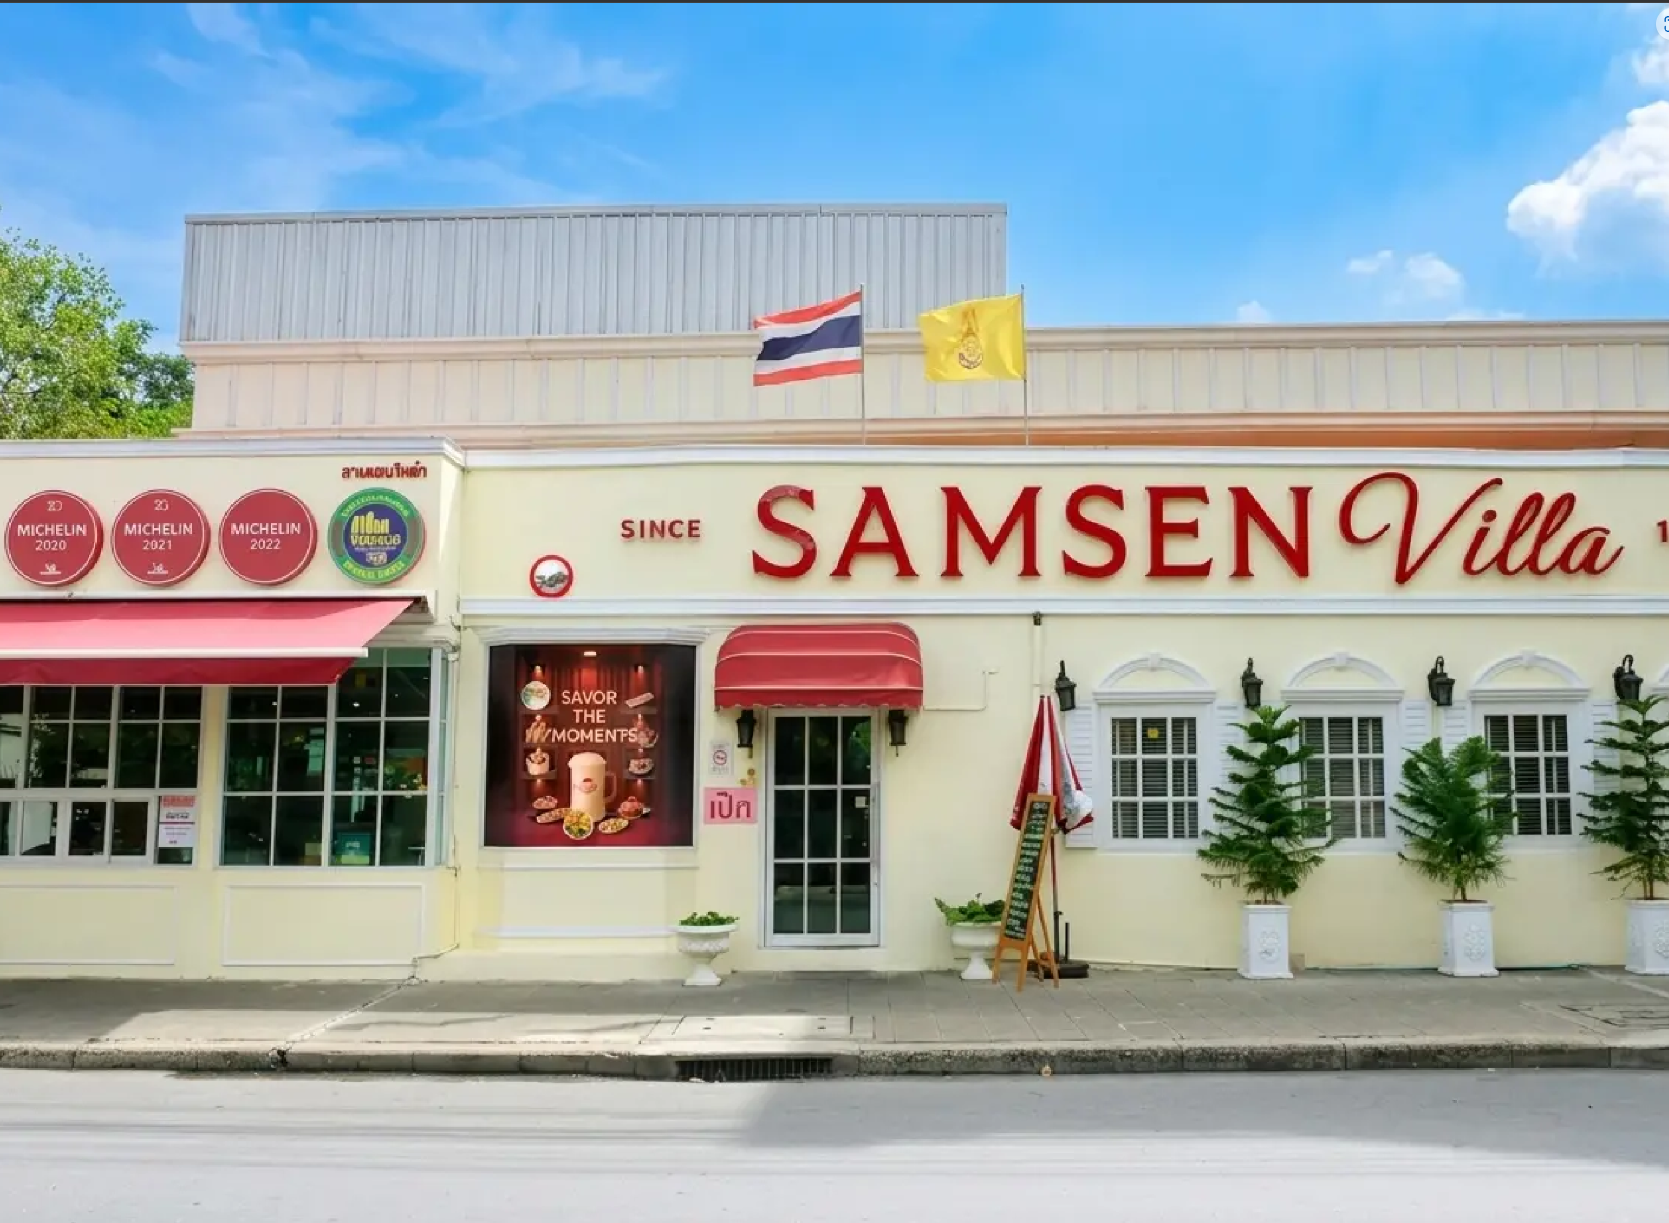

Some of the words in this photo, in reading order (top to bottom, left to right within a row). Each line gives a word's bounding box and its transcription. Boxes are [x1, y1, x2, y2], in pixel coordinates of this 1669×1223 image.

[17, 524, 87, 537] MICHELIN
[124, 522, 193, 536] MICHELIN
[230, 522, 301, 535] MICHELIN
[621, 519, 702, 540] SINCE
[752, 483, 1312, 581] SAMSEN
[1339, 472, 1623, 585] Villa
[35, 539, 67, 551] 2020
[143, 539, 172, 551] 2021
[249, 538, 281, 550] 2022
[561, 690, 617, 705] SAVOR
[573, 709, 606, 724] THE
[551, 728, 638, 743] MOMENTS
